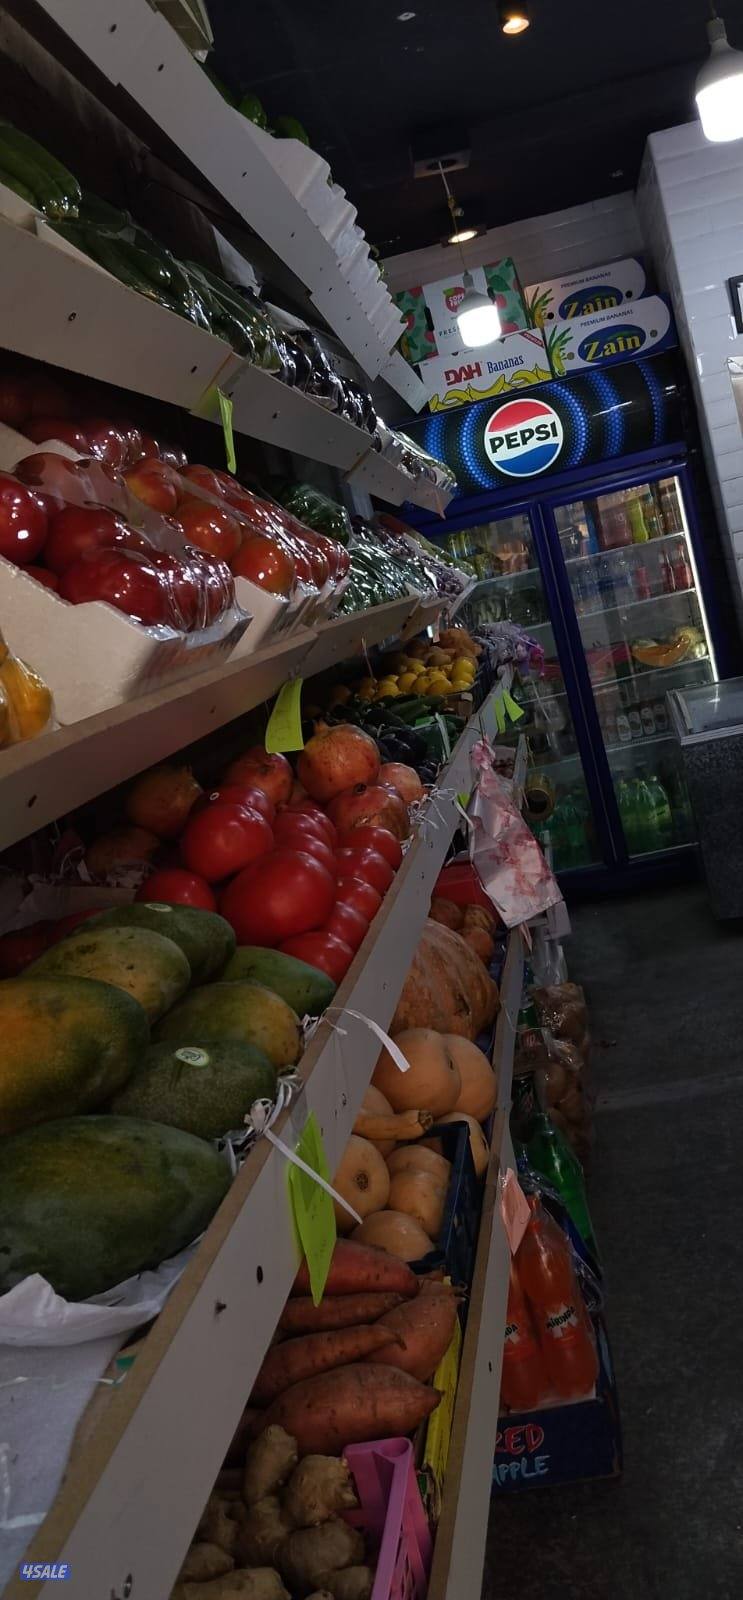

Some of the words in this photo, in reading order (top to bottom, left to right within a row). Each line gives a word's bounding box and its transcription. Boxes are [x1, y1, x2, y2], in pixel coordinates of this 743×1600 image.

[585, 272, 612, 283] BANANAS
[564, 295, 617, 320] Zain
[580, 316, 606, 328] PREMIUM
[606, 309, 633, 321] BANANAS
[584, 335, 641, 361] Zain
[444, 361, 482, 386] DAH
[486, 355, 525, 374] Bananas
[489, 420, 558, 454] PEPSI
